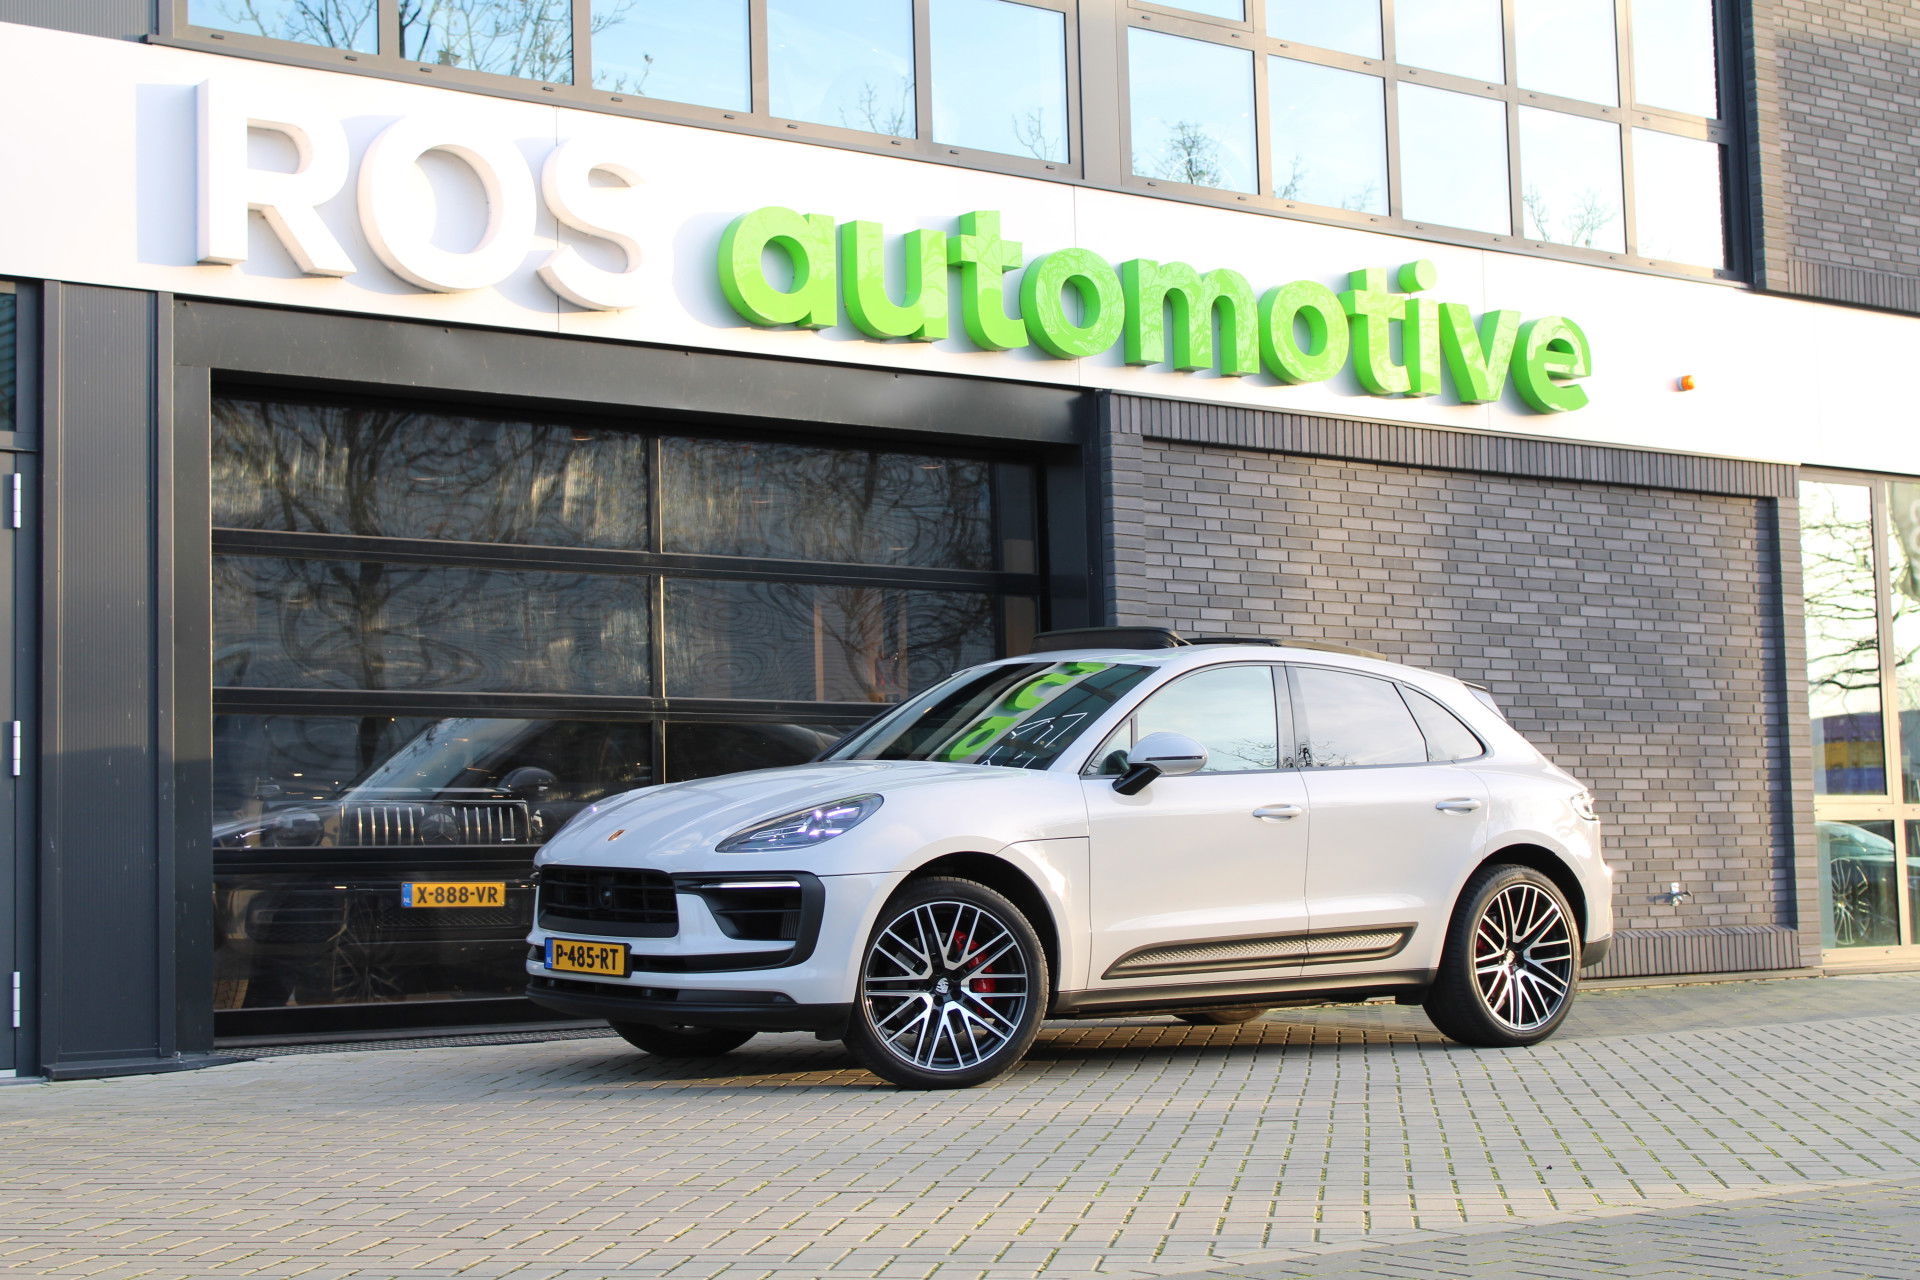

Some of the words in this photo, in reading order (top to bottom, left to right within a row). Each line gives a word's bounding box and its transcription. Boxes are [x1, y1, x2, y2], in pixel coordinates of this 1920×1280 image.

[196, 78, 652, 312] ROS
[717, 206, 1591, 411] automotive
[417, 886, 498, 904] X-888-VR
[556, 944, 619, 970] P-485-RT
